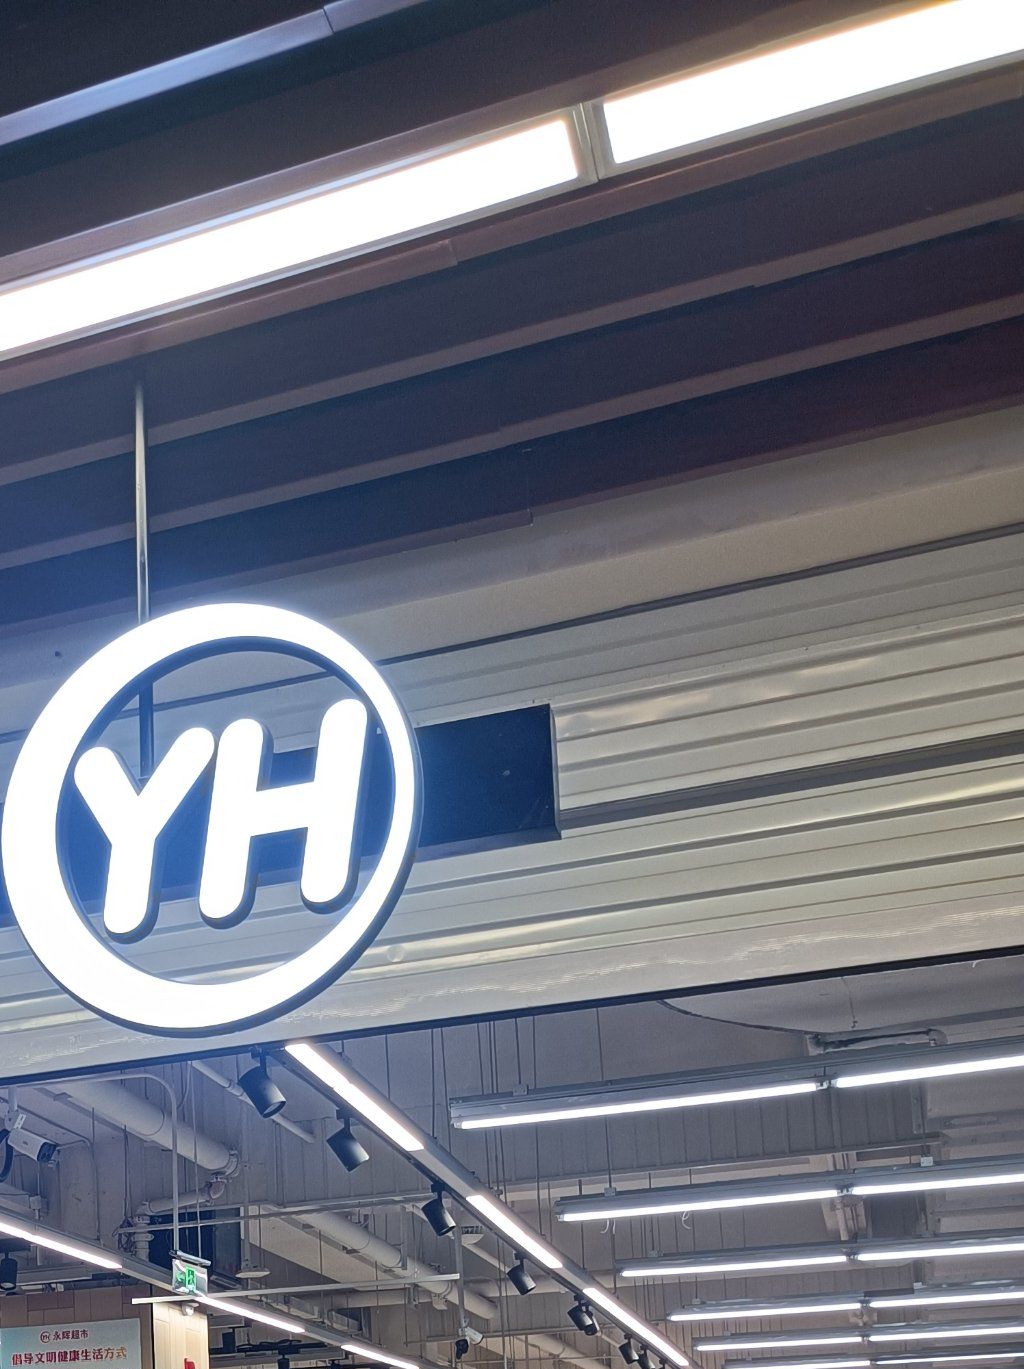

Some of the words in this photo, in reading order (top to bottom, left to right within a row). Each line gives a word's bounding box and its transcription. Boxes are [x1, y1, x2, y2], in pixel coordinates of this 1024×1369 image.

[74, 696, 370, 940] YH
[53, 1329, 88, 1341] 永辉超市
[12, 1346, 127, 1365] 倡导文明健康生活方式
